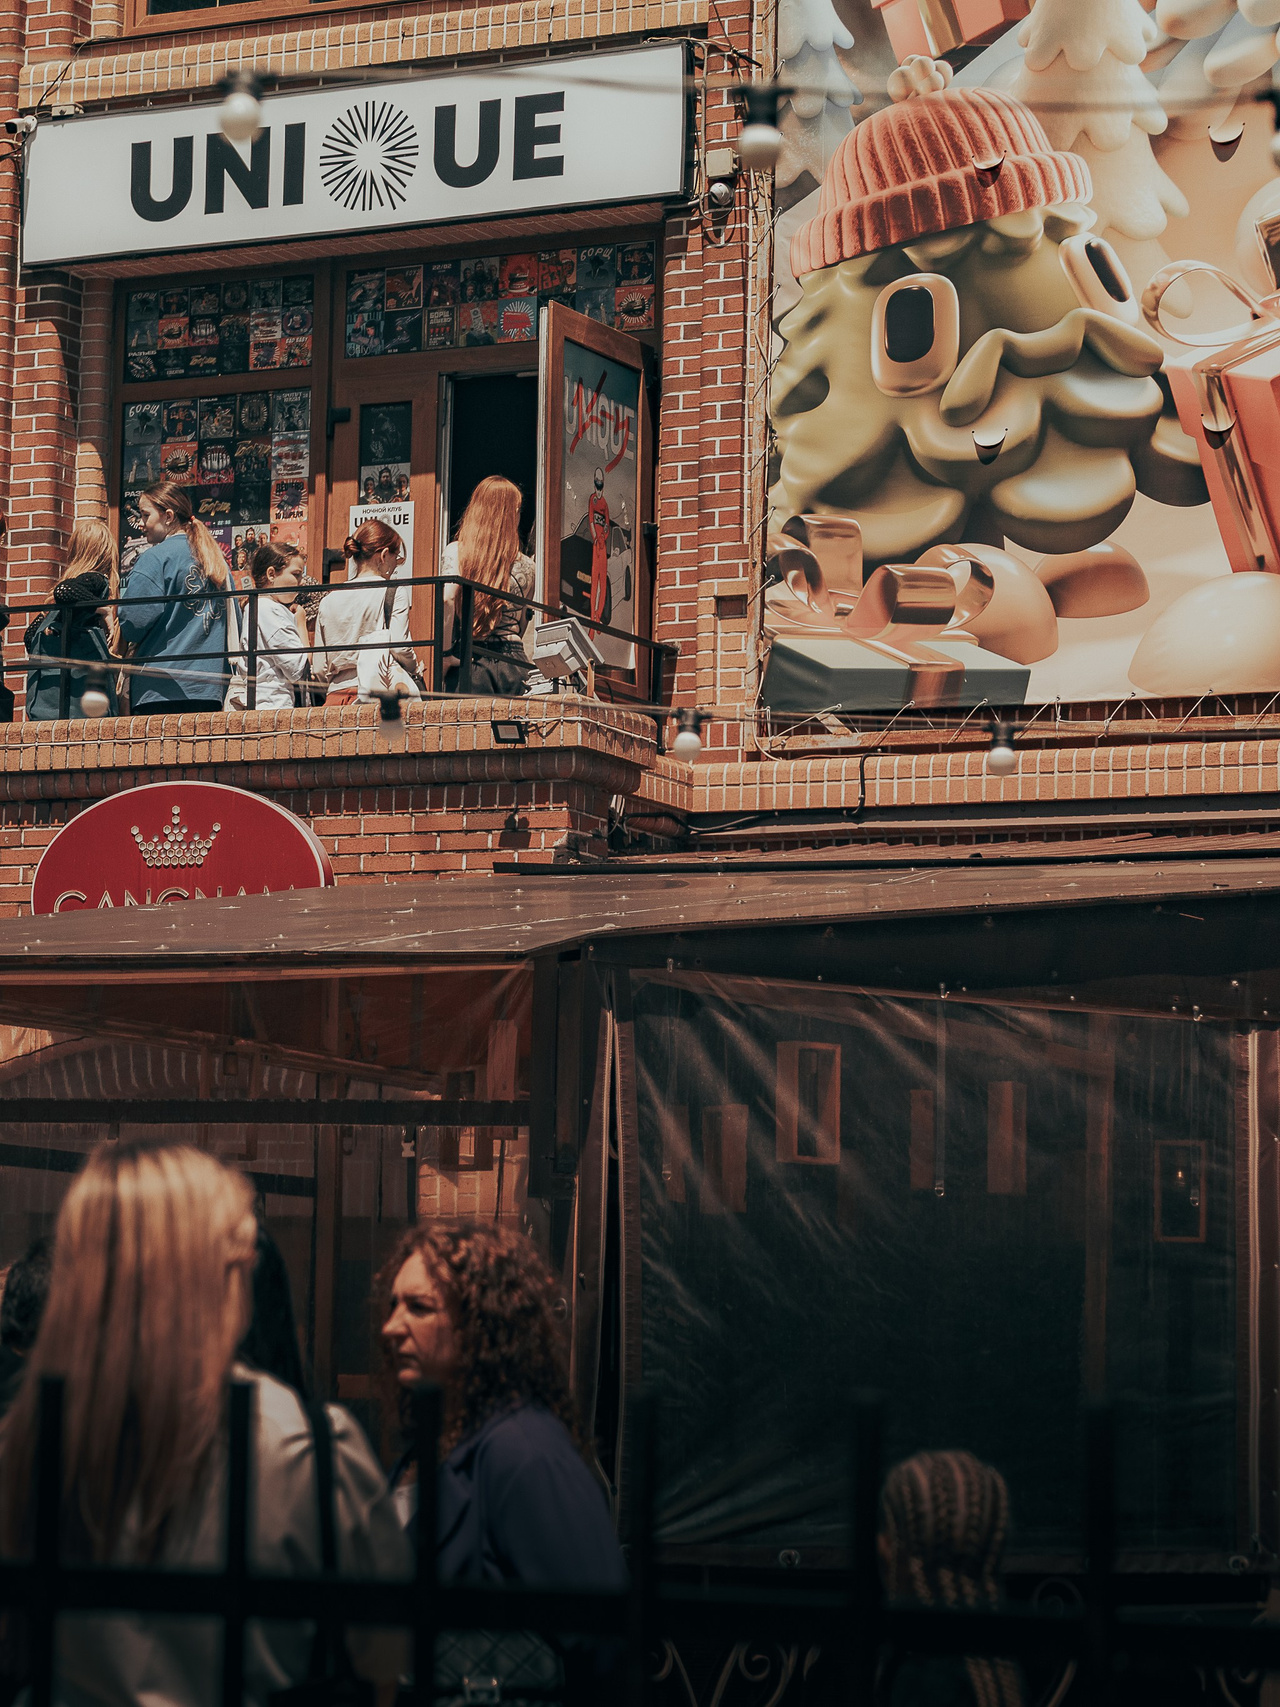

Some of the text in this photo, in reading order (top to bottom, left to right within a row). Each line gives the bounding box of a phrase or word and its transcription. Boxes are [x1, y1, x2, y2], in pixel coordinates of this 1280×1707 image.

[130, 90, 565, 222] UNIQUE
[128, 403, 160, 418] БОРЩ
[564, 375, 635, 461] UNIQUE
[362, 506, 387, 514] НОЧНОЙ
